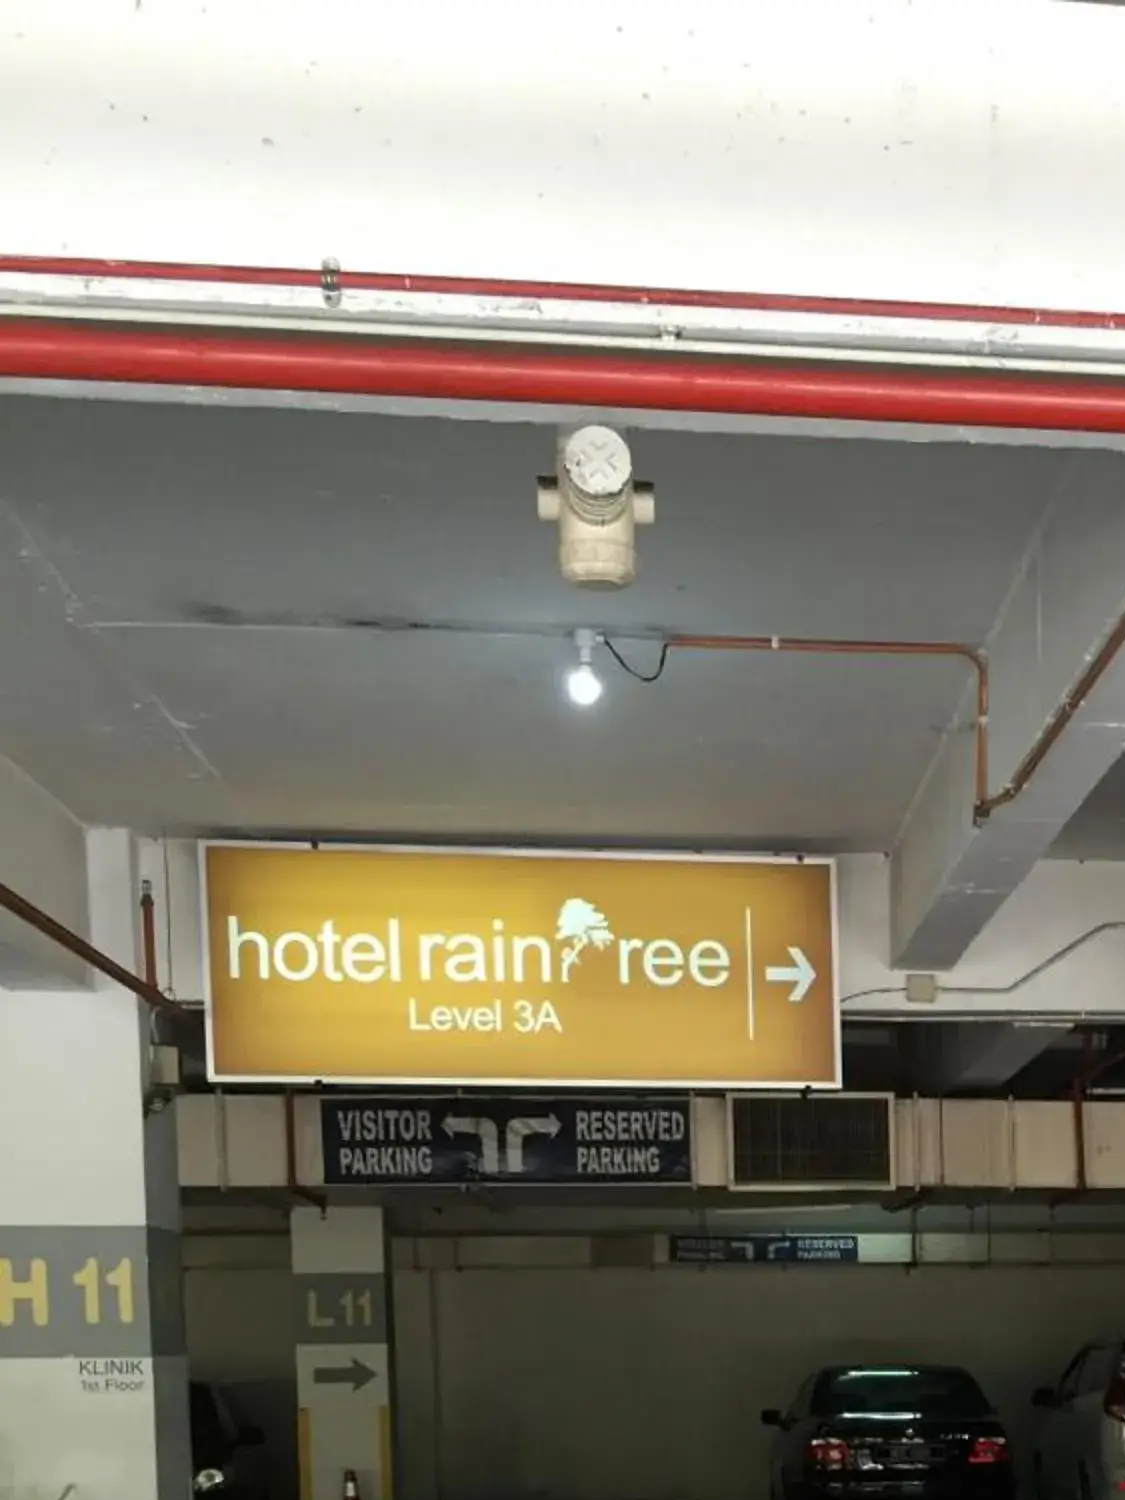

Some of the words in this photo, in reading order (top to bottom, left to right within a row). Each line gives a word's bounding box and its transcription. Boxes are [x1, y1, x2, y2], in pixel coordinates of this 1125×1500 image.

[227, 914, 402, 983] hotel
[409, 998, 503, 1034] Level
[513, 1000, 563, 1034] 3A
[337, 1110, 433, 1142] VISITOR
[575, 1110, 685, 1142] RESERVED
[339, 1146, 433, 1176] PARKING
[576, 1146, 660, 1175] PARKING
[0, 1257, 49, 1327] H
[72, 1256, 135, 1325] 11
[78, 1359, 145, 1376] KLINIK
[80, 1379, 100, 1392] 1st
[104, 1378, 146, 1392] Floor
